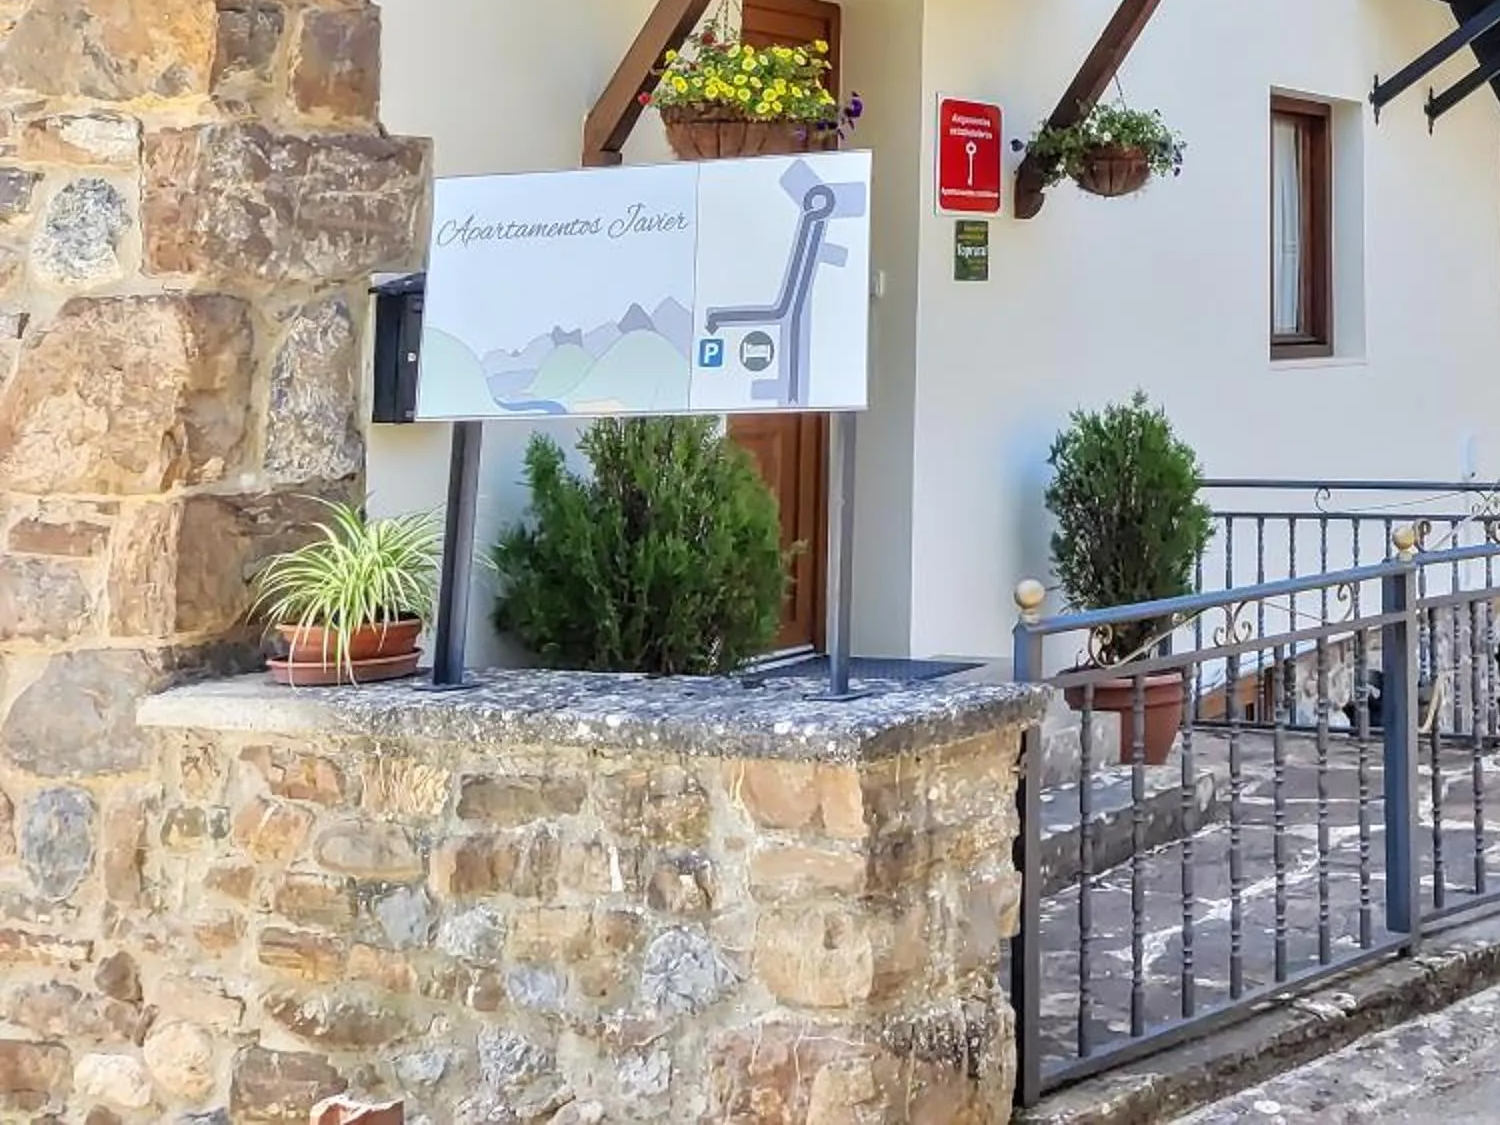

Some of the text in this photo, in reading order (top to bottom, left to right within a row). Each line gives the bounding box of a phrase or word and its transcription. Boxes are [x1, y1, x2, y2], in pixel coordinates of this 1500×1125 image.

[437, 202, 689, 248] Apartamentos Javier
[703, 342, 719, 364] P
